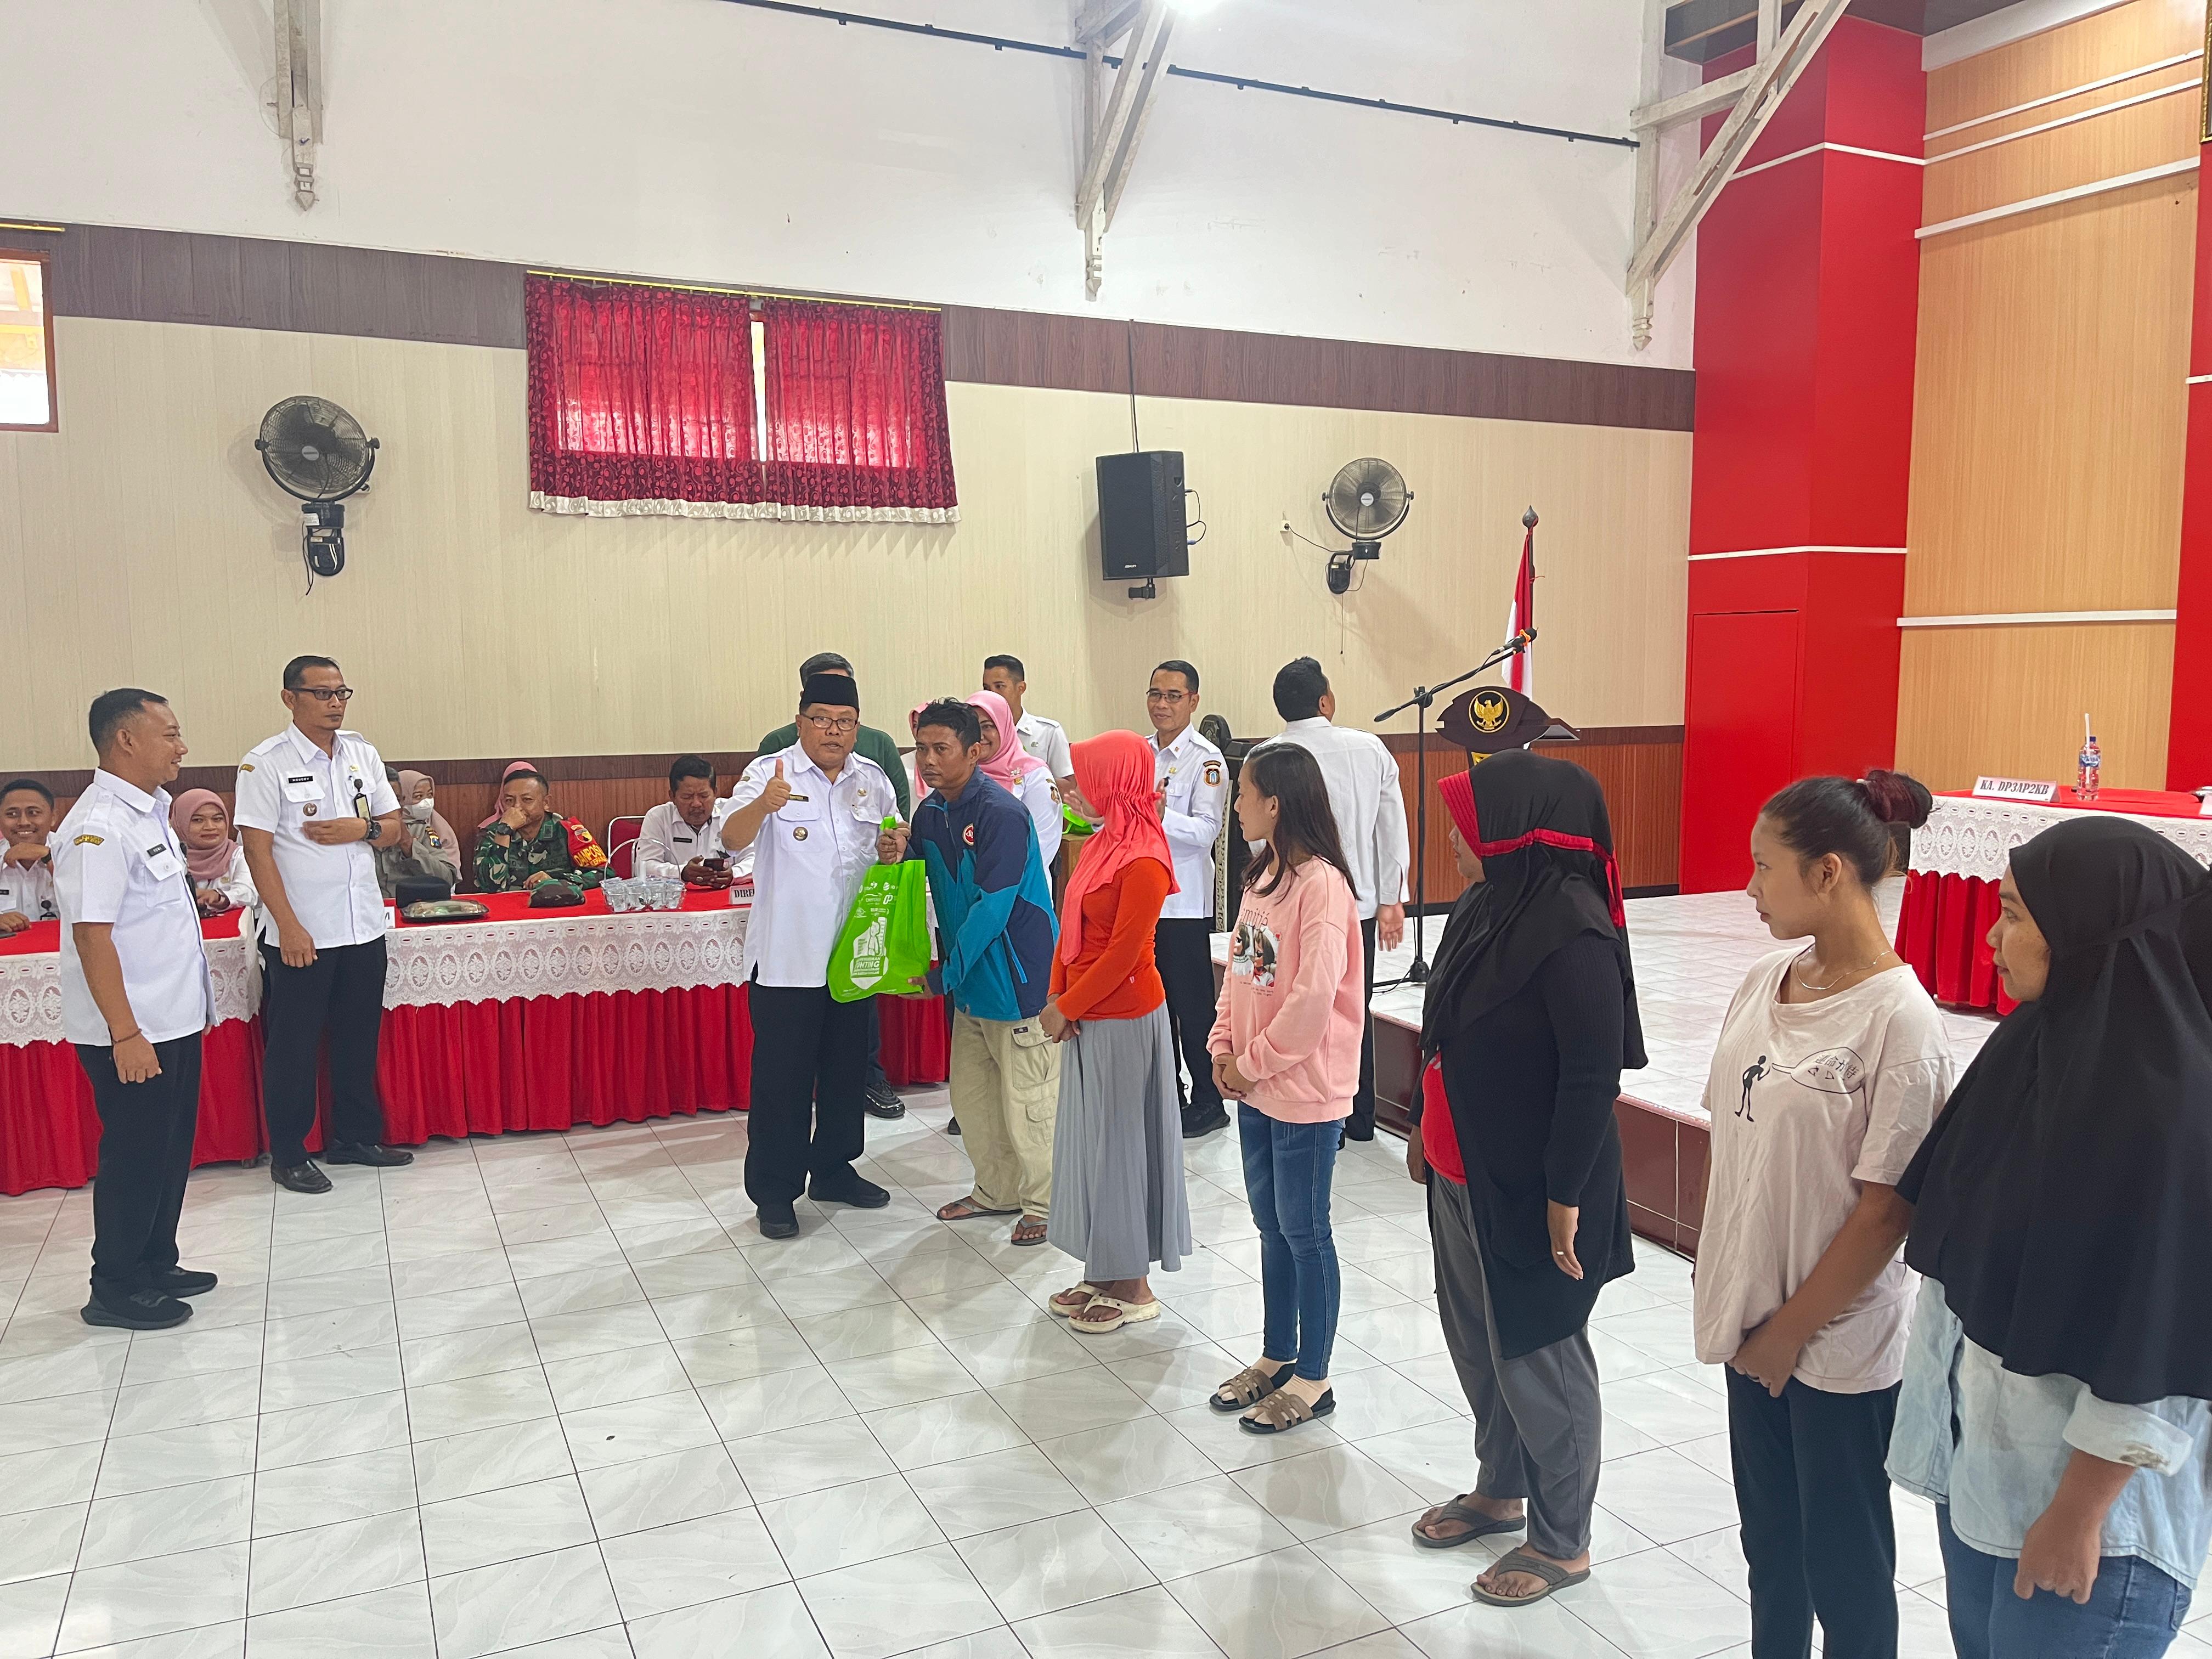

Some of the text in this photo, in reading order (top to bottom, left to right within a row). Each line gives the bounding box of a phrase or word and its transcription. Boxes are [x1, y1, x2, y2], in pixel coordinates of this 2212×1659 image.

[1980, 780, 2049, 794] KA. DP3AP2KB
[734, 888, 754, 898] DIRE
